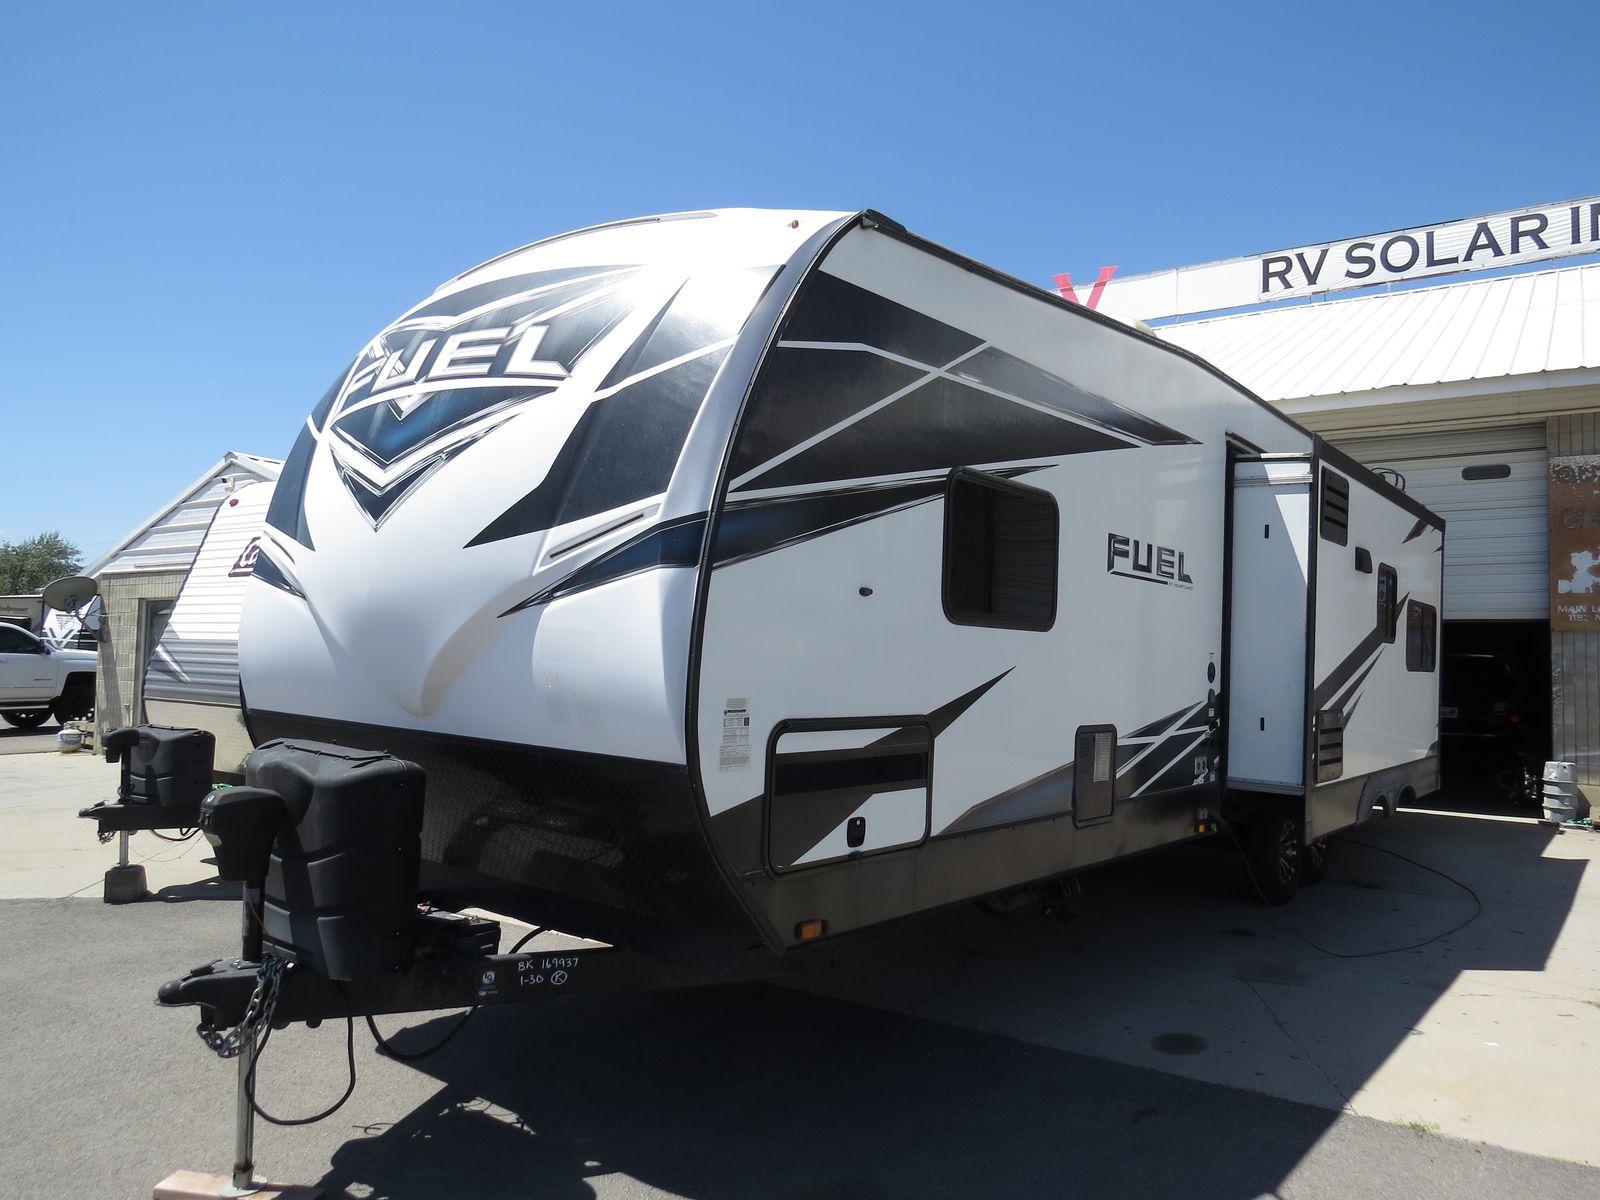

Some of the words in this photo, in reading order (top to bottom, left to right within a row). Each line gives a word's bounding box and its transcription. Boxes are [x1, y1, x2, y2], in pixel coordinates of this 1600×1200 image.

[1261, 248, 1330, 293] RV
[1344, 212, 1551, 279] SOLAR
[340, 325, 572, 400] FUEL
[1107, 532, 1193, 585] FUEL
[518, 959, 534, 972] BK
[520, 974, 544, 986] 1-30
